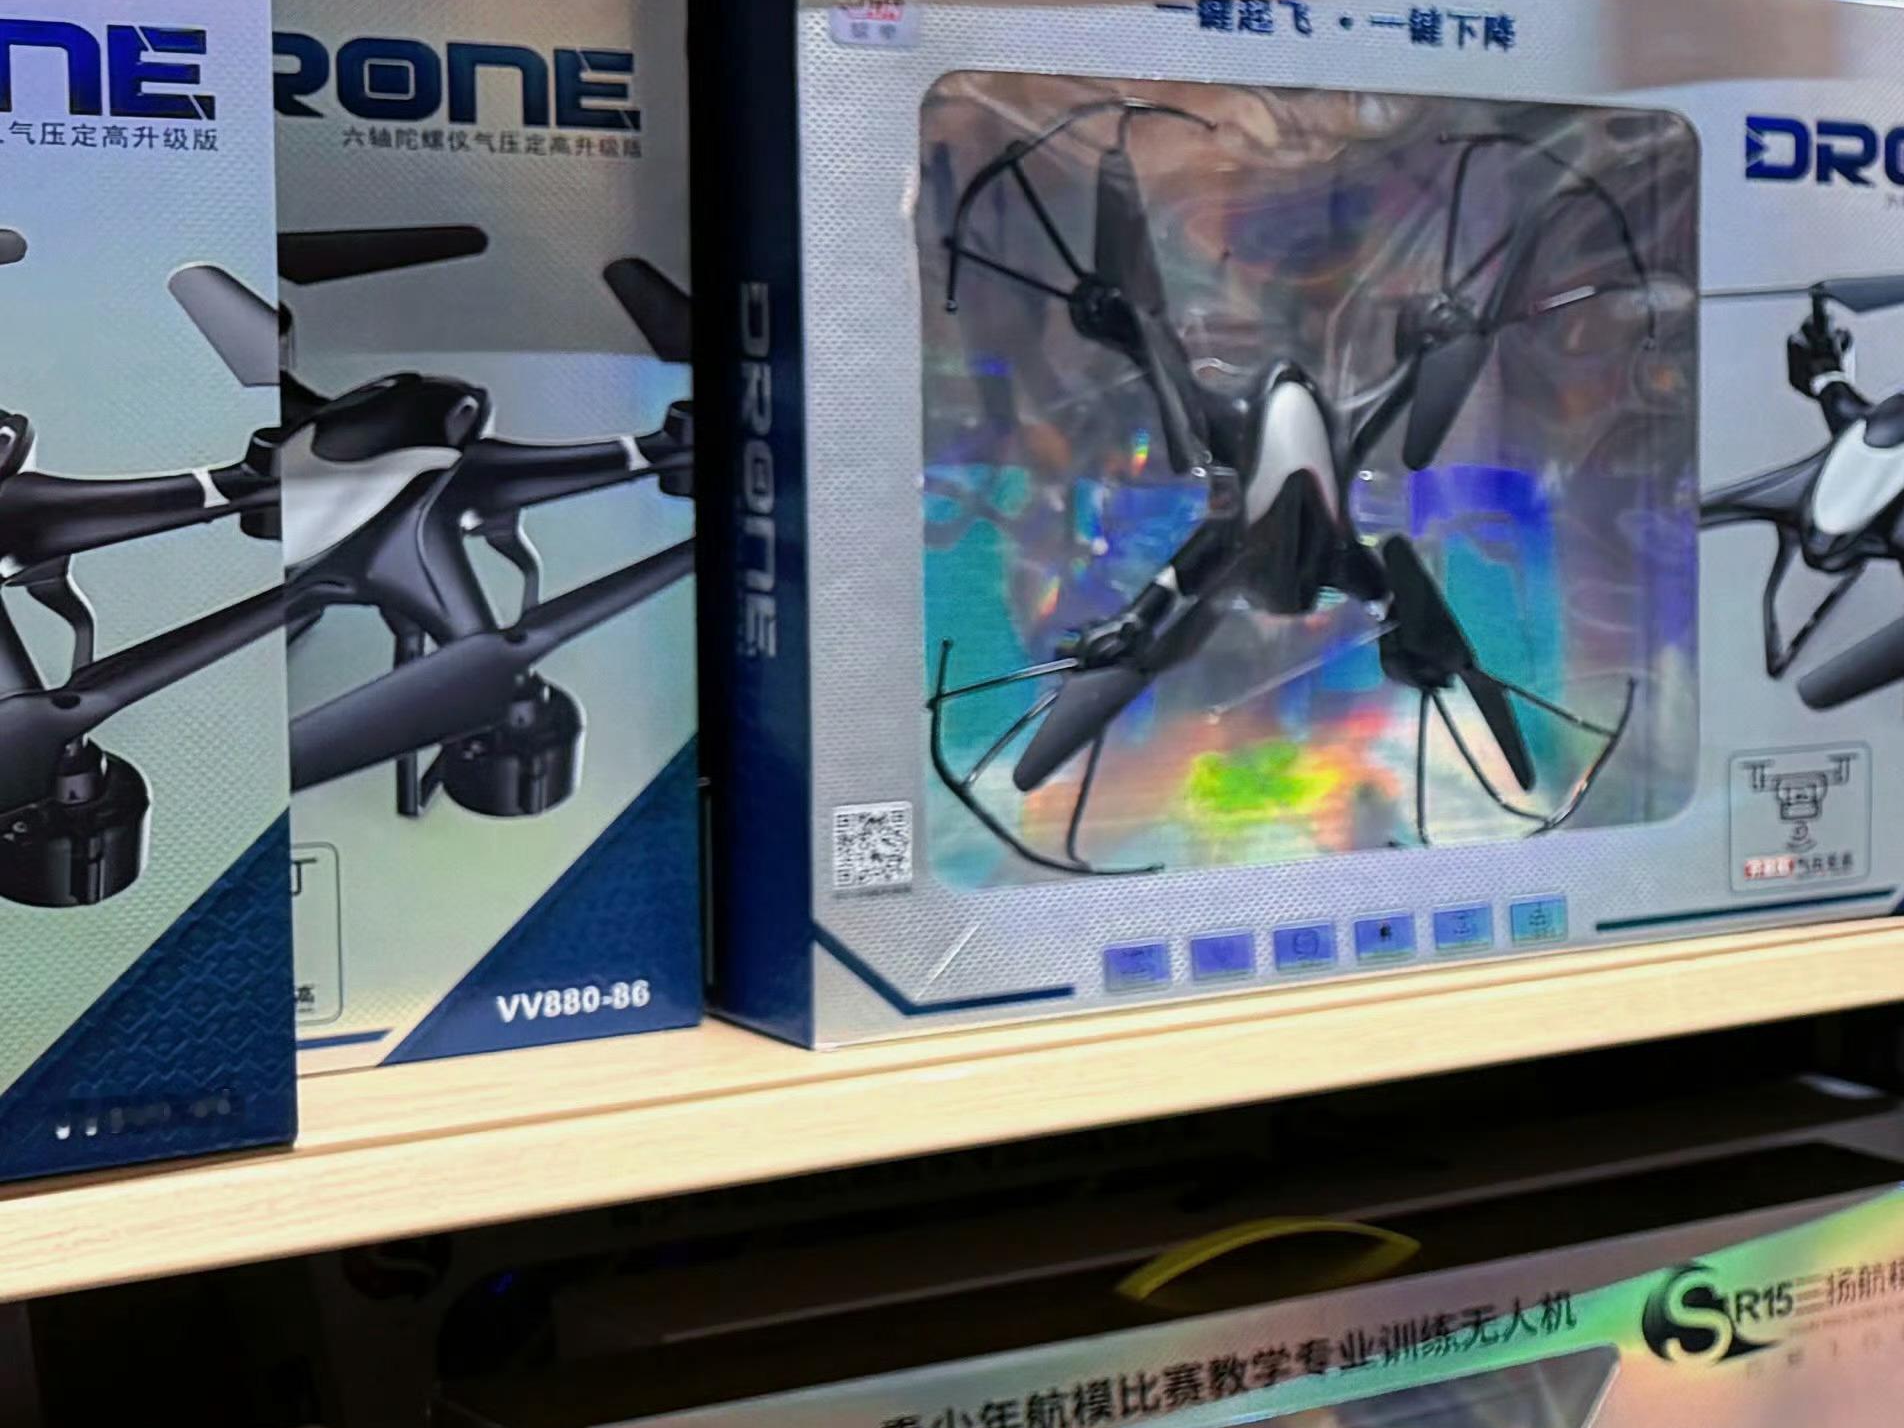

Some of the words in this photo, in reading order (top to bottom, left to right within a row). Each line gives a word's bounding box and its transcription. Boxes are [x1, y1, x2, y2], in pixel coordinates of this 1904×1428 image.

[272, 31, 642, 132] RONE
[740, 283, 777, 659] DRONE
[496, 979, 651, 1023] VV880-86
